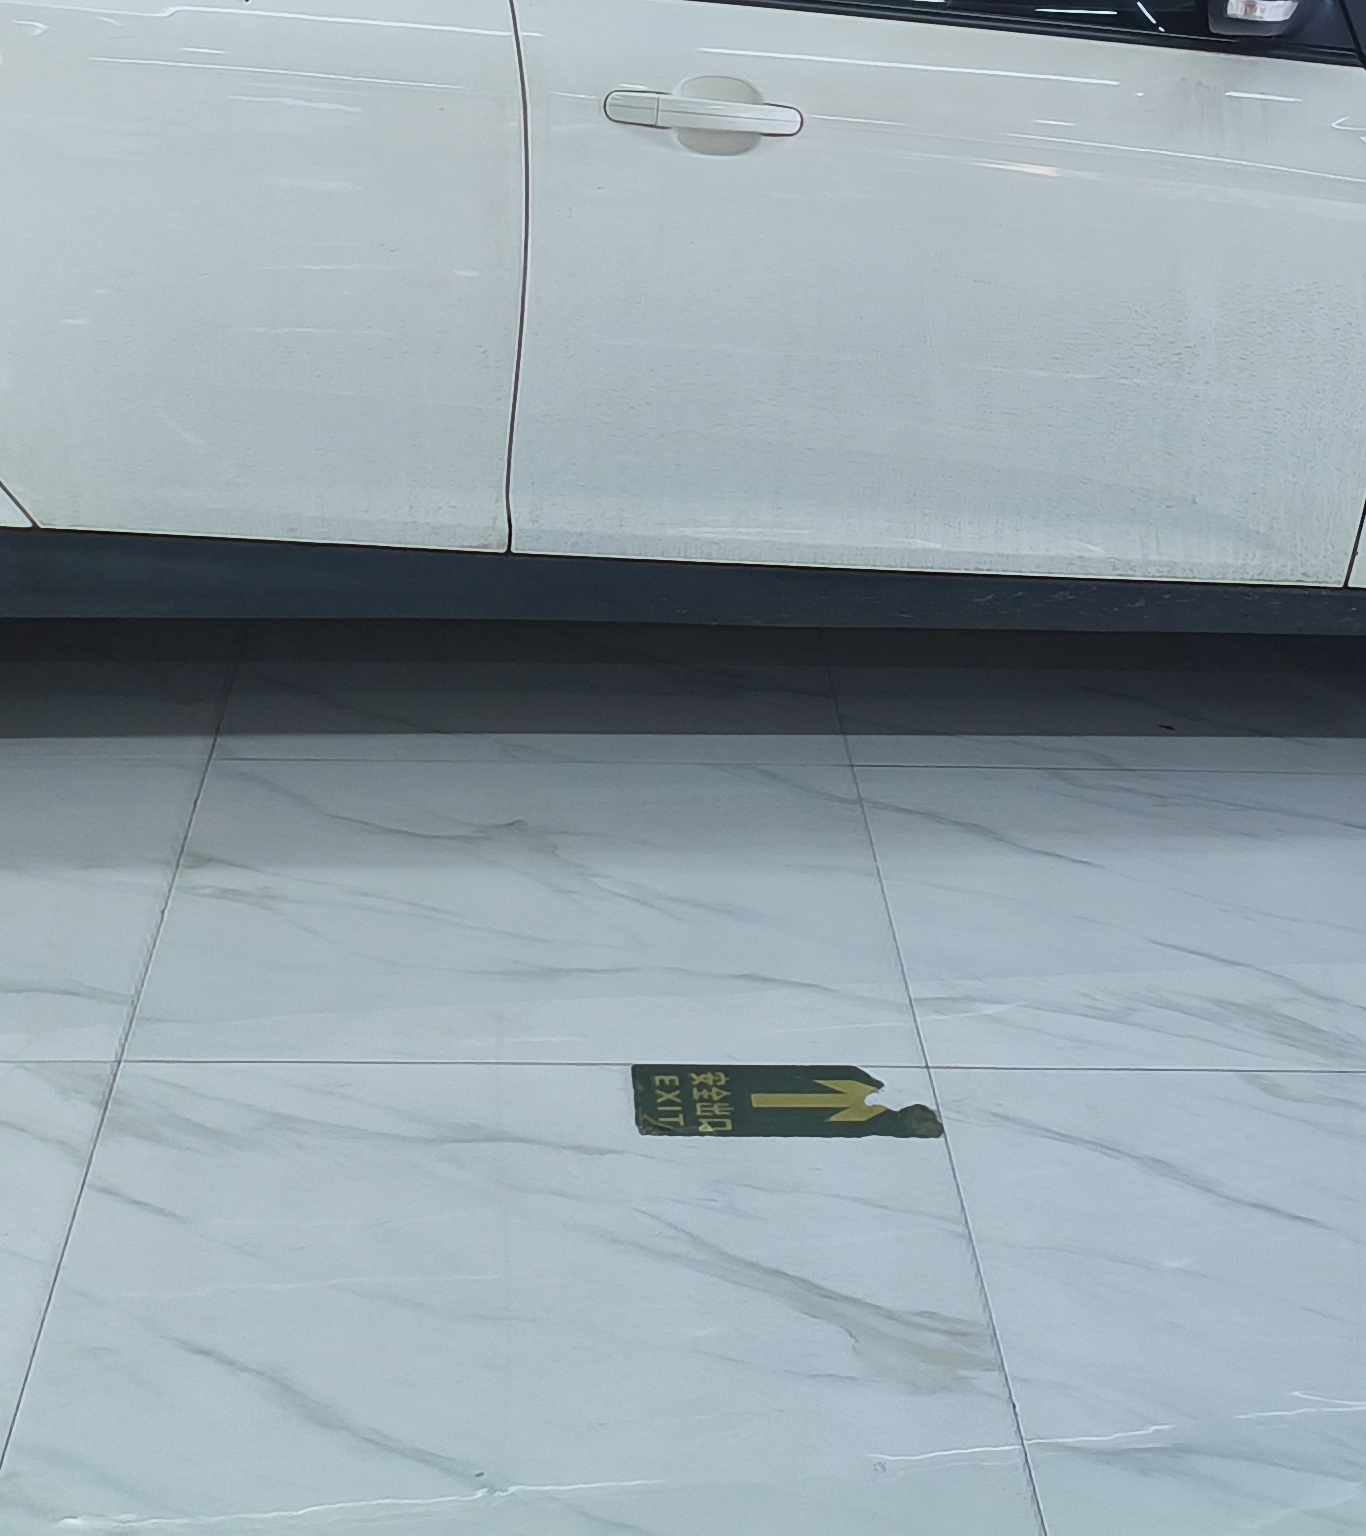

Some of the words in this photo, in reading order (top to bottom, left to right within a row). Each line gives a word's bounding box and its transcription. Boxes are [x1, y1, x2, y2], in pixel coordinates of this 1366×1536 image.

[655, 1074, 685, 1127] EXIT
[688, 1070, 735, 1132] 安全出口
